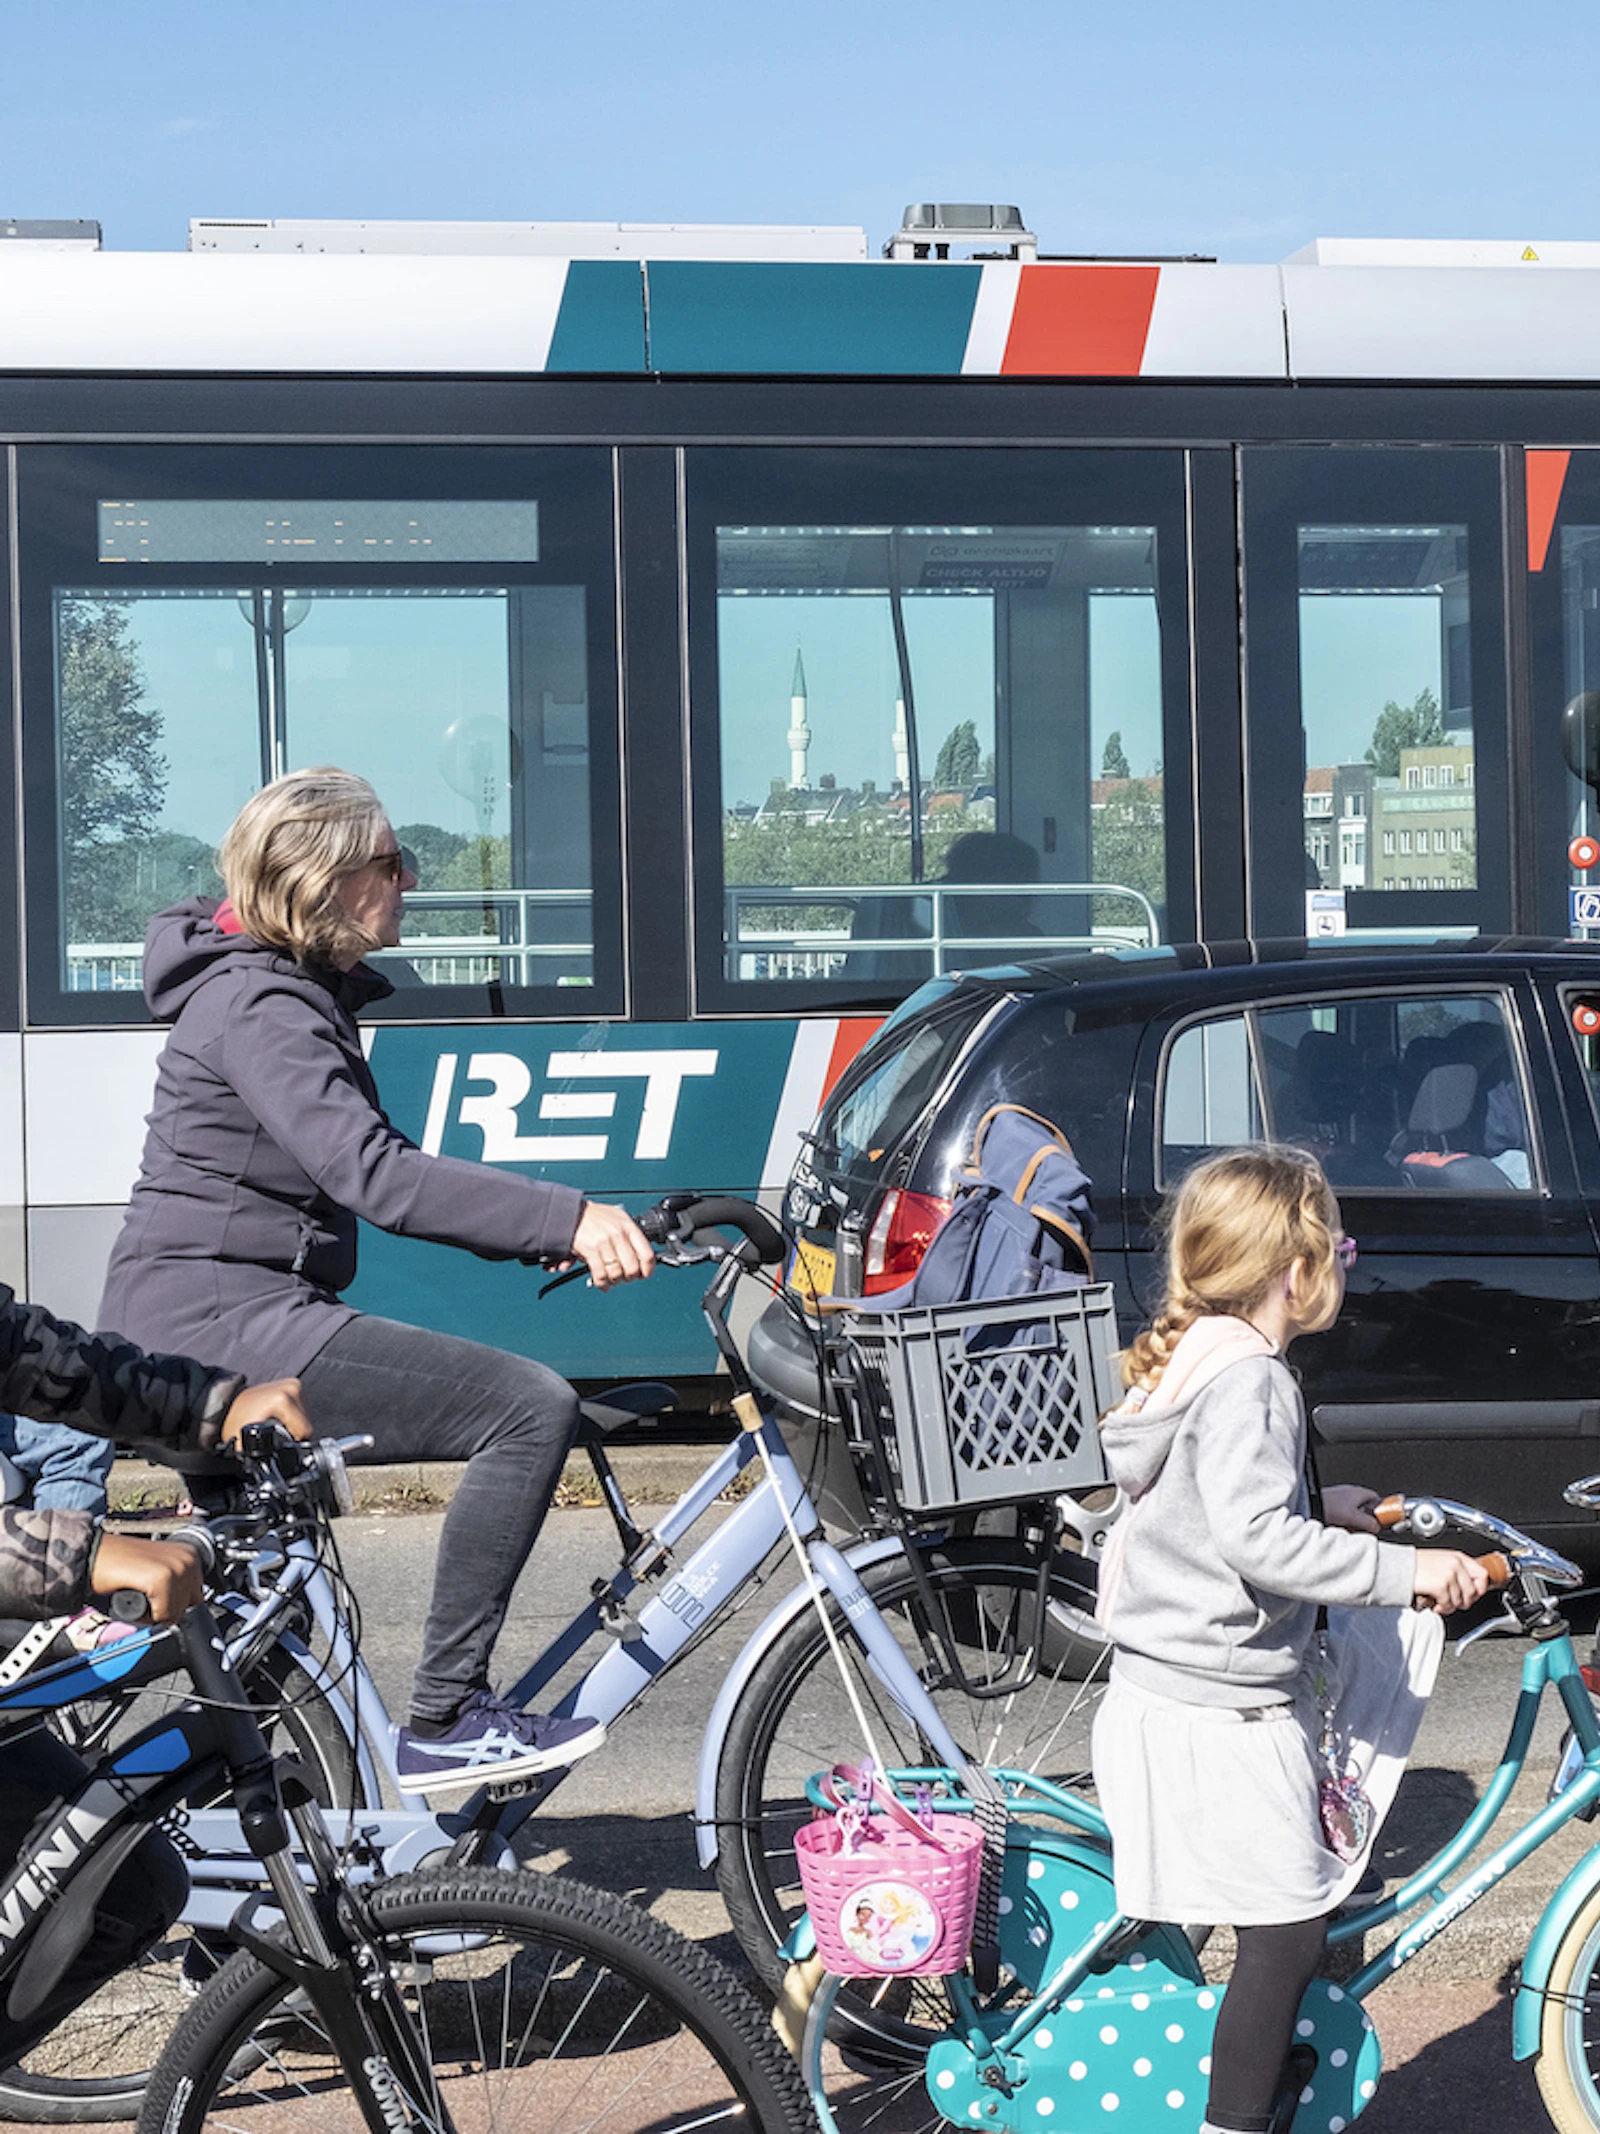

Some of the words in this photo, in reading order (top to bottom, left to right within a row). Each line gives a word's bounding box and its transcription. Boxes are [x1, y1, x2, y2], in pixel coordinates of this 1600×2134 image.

[926, 568, 985, 578] CHECK
[987, 568, 1048, 578] ALTIJD
[420, 1049, 719, 1162] RET
